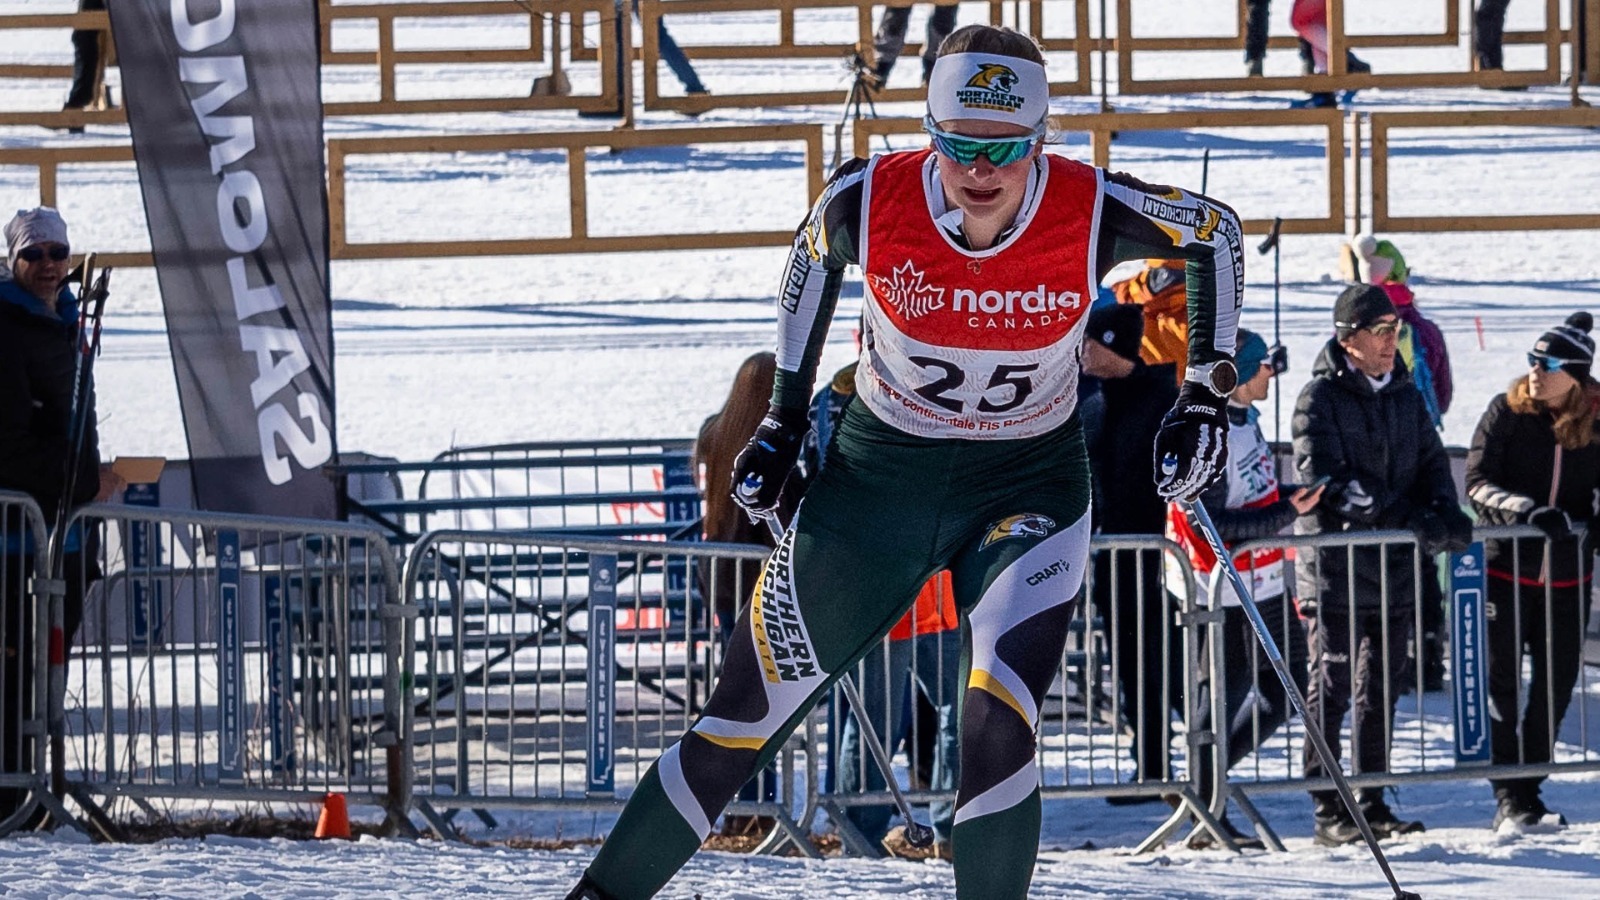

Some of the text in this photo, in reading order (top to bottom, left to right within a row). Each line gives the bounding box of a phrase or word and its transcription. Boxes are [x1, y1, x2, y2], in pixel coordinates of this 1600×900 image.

[956, 90, 1025, 103] NORTHERN
[959, 97, 1021, 109] MICHIGAN
[1143, 197, 1197, 226] MICHIGAN
[968, 311, 1068, 329] CANADA
[908, 355, 1040, 414] 25
[979, 421, 1000, 431] FIS
[1025, 561, 1064, 587] CRAFT
[775, 529, 817, 678] NORTHERN
[754, 581, 776, 676] ILDCATS
